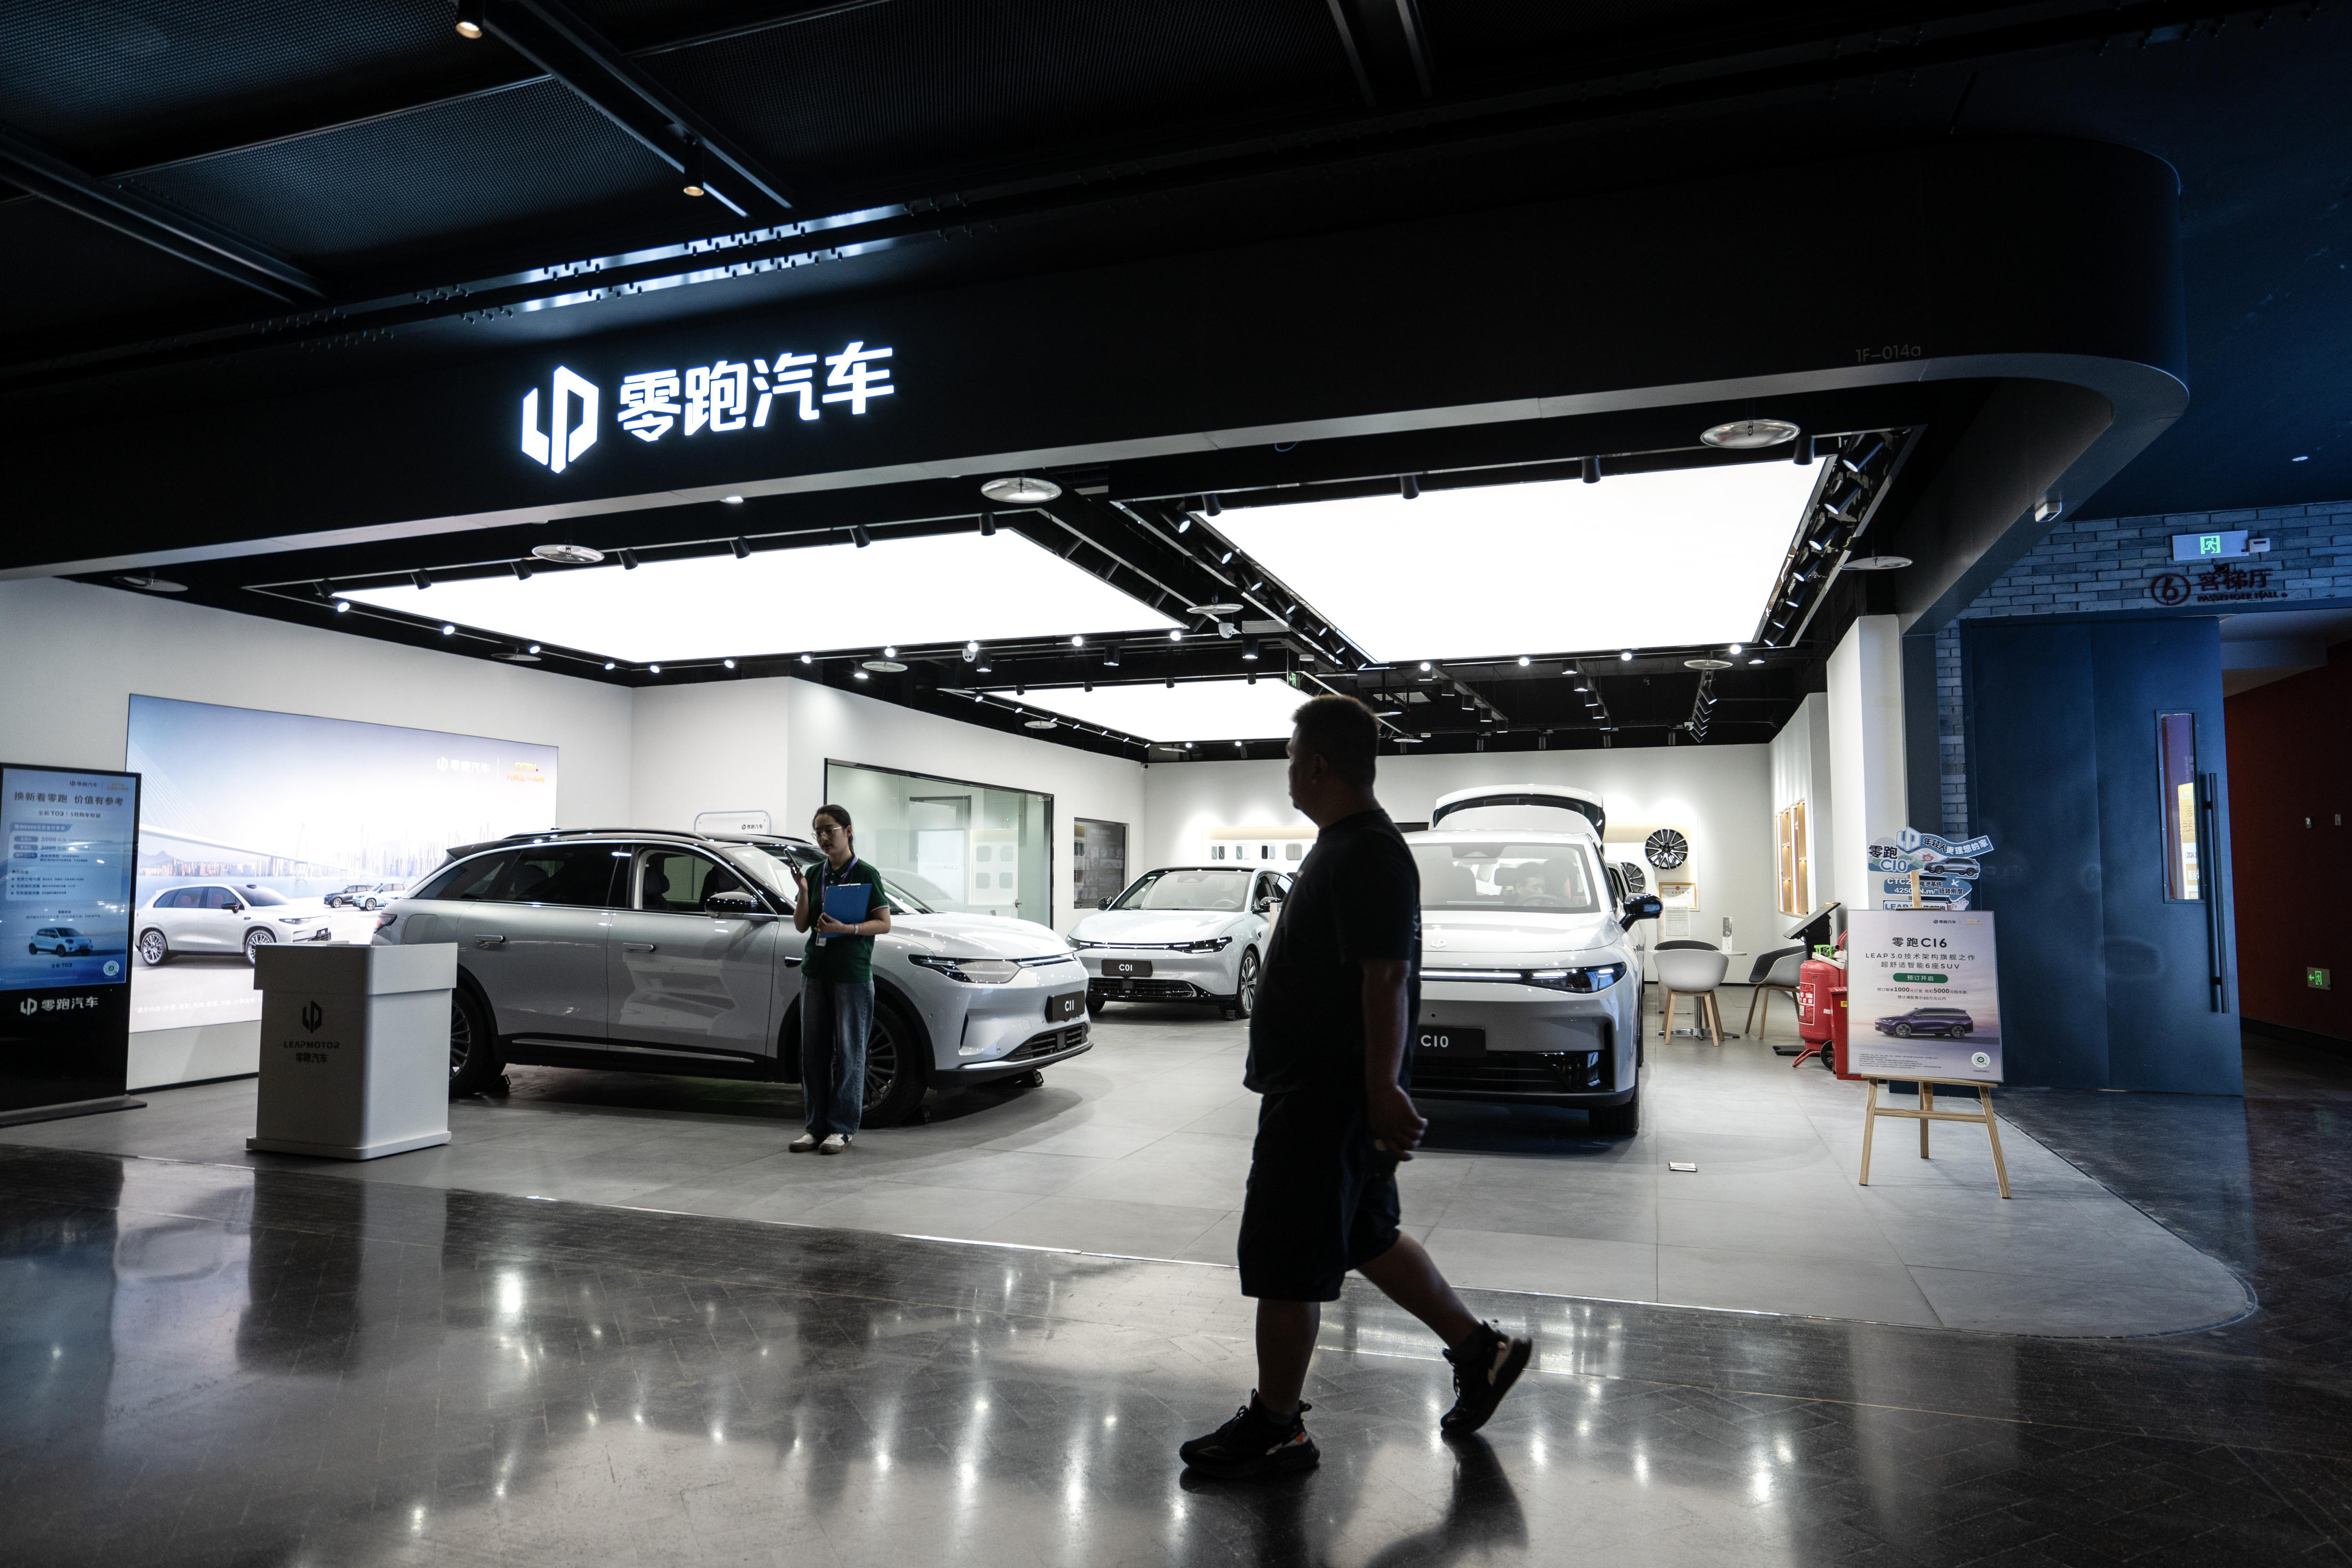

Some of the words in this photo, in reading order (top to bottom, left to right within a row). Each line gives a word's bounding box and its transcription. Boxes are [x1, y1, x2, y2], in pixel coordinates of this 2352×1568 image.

[618, 341, 894, 442] 零跑汽车
[2197, 569, 2274, 592] 客梯厅
[2197, 593, 2252, 602] PASSENGER
[2255, 591, 2279, 600] HALL
[14, 791, 68, 804] 换新看零跑
[74, 794, 124, 806] 价值有参考
[1869, 845, 1898, 859] 零跑
[1923, 837, 1989, 855] 年轻人更理想的家
[1880, 859, 1908, 872] C10
[1119, 963, 1133, 972] C01
[41, 996, 98, 1011] 零跑汽车
[284, 1040, 339, 1050] LEAPMOTOR
[1420, 1035, 1449, 1048] C10
